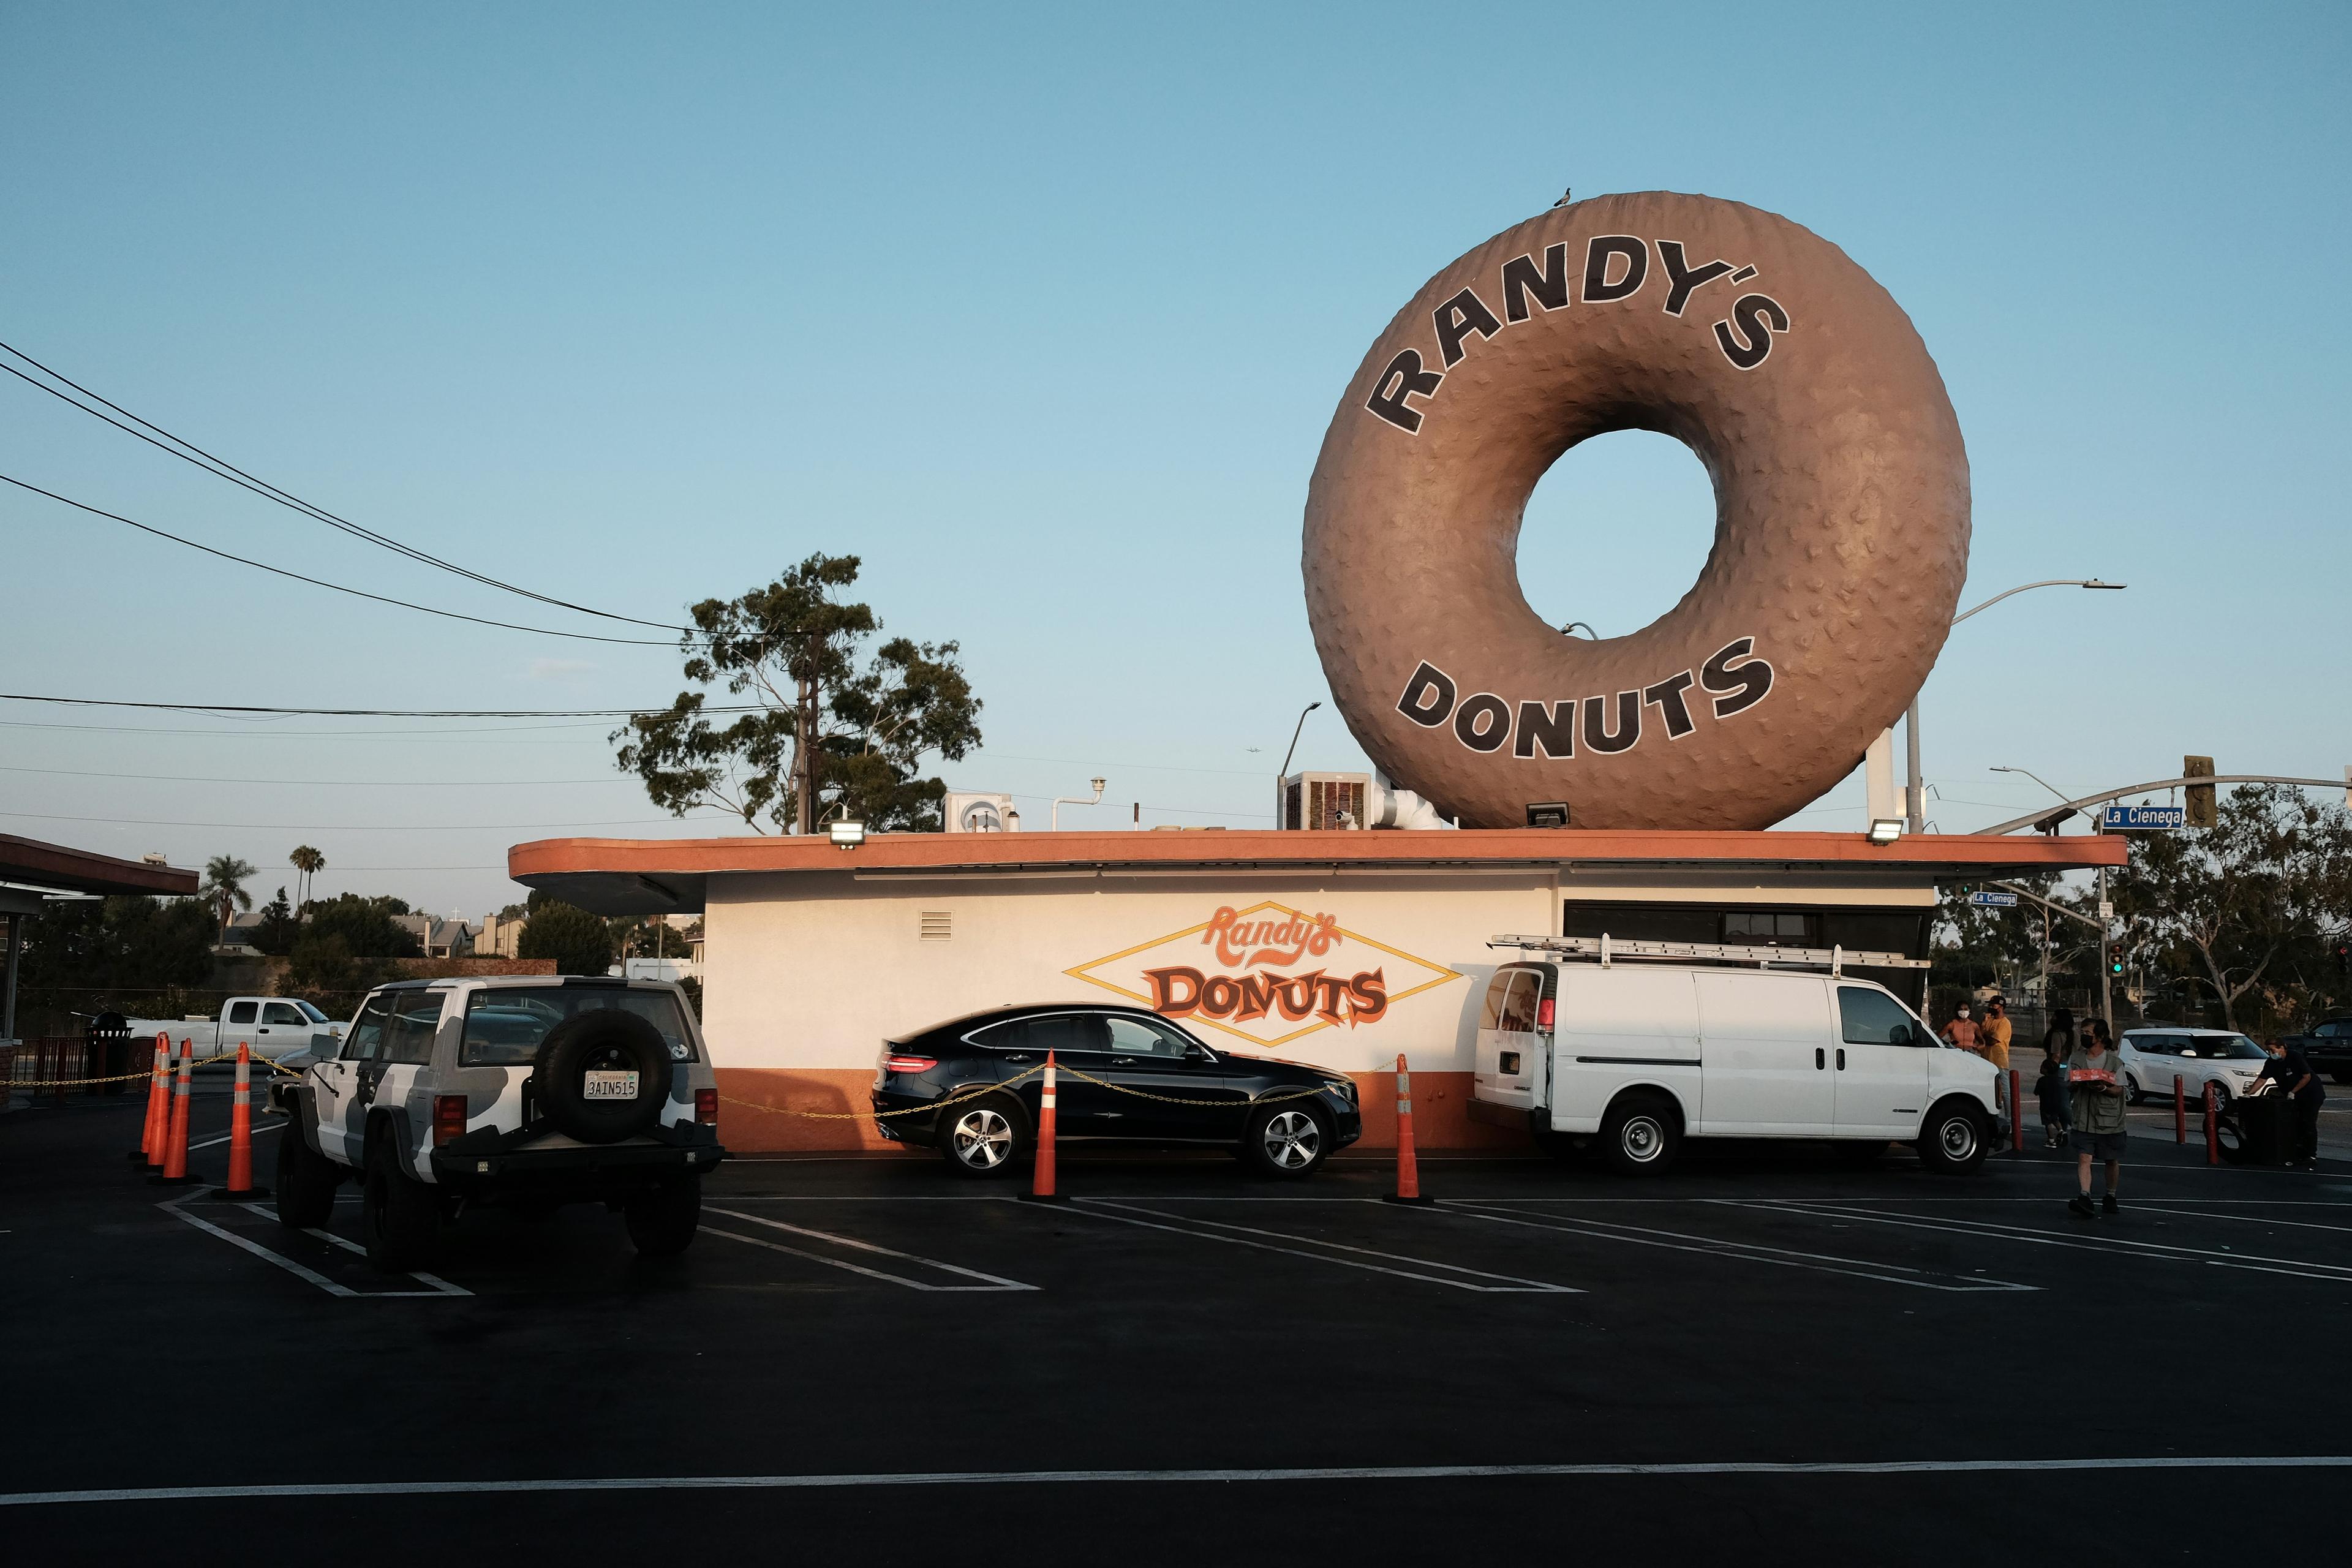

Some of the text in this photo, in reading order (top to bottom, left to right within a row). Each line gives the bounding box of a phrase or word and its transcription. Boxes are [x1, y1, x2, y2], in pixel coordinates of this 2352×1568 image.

[1364, 235, 1790, 436] RANDY'S
[1395, 636, 1775, 760] DONUTS
[2105, 807, 2181, 828] La Cienega
[1975, 892, 2016, 906] La Cienega
[1200, 906, 1343, 970] Randy's
[1140, 966, 1389, 1030] DONUTS
[588, 1081, 635, 1095] 3AIN515
